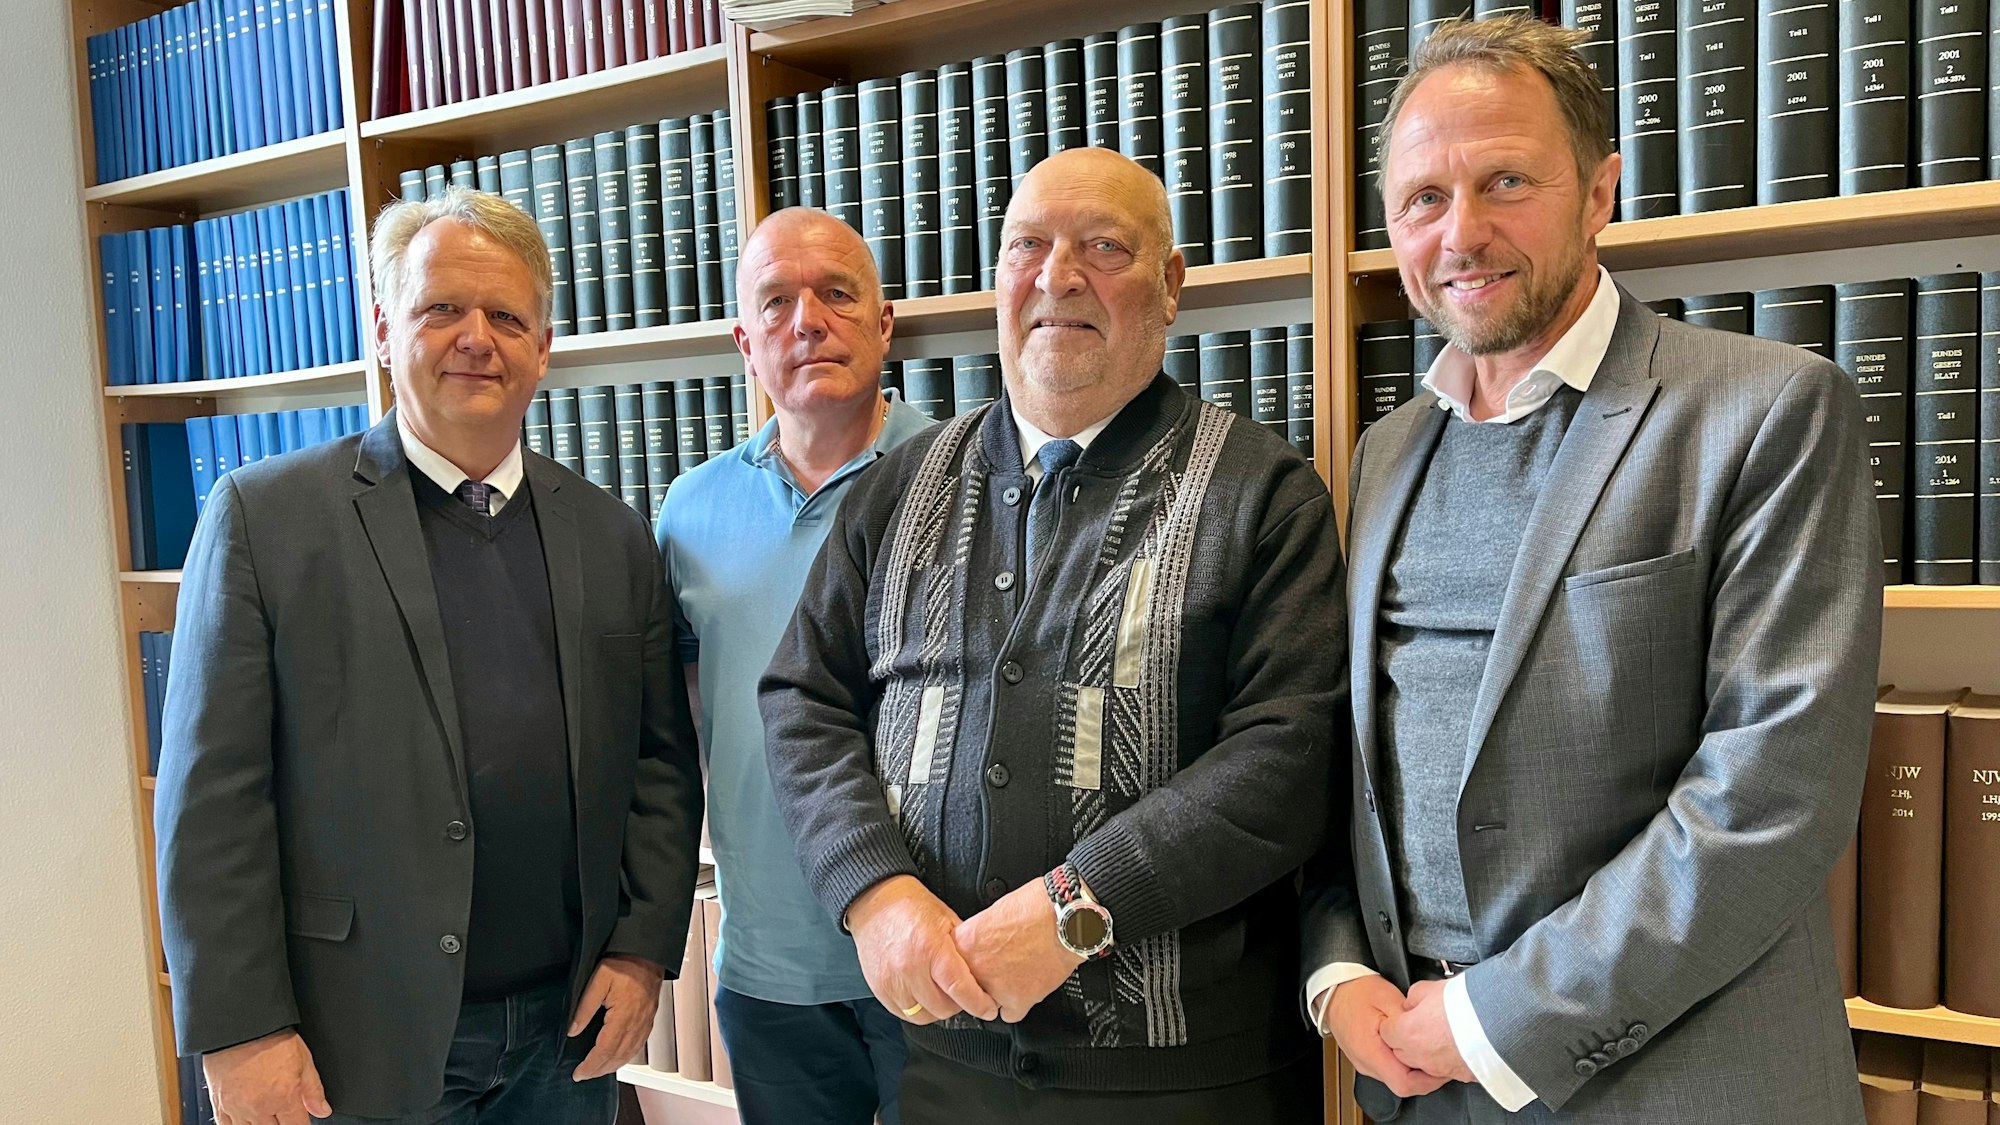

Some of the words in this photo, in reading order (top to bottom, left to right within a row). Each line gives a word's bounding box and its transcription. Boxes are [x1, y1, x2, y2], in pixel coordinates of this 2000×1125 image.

[1576, 3, 1602, 13] BUNDES
[1635, 3, 1661, 13] GESETZ
[1703, 3, 1726, 13] BLATT
[1940, 7, 1954, 15] Teil
[1577, 14, 1602, 23] GESETZ
[1636, 14, 1658, 24] BLATT
[1864, 16, 1877, 24] Teil
[1789, 29, 1802, 38] Teil
[1369, 42, 1391, 52] BUNDES
[1706, 44, 1718, 52] Teil
[1719, 42, 1724, 50] II
[1276, 52, 1297, 61] BUNDES
[1369, 53, 1390, 62] GESETZ
[1639, 54, 1652, 62] Teil
[1938, 50, 1960, 61] 2001
[1276, 62, 1296, 70] GESETZ
[1370, 63, 1388, 71] BLATT
[1862, 59, 1885, 70] 2001
[1220, 65, 1240, 74] BUNDES
[1947, 66, 1954, 74] 2
[1221, 74, 1240, 82] GESETZ
[1279, 71, 1295, 79] BLATT
[1787, 72, 1808, 83] 2001
[1871, 74, 1877, 83] 1
[1126, 83, 1144, 91] BUNDES
[1171, 82, 1189, 90] GESETZ
[1222, 83, 1239, 91] BLATT
[1704, 84, 1726, 95] 2000
[1089, 89, 1107, 97] BUNDES
[1127, 92, 1144, 100] GESETZ
[1172, 92, 1188, 100] BLATT
[1090, 99, 1106, 107] GESETZ
[1638, 94, 1658, 105] 2000
[1128, 101, 1144, 109] BLATT
[1712, 100, 1717, 108] 1
[1644, 109, 1650, 117] 2
[1280, 142, 1295, 150] 1998
[1223, 152, 1237, 160] 1998
[1174, 159, 1188, 167] 1998
[1932, 350, 1963, 358] BUNDES
[1856, 354, 1887, 363] BUNDES
[1857, 365, 1885, 373] GESETZ
[1933, 361, 1962, 369] GESETZ
[1858, 376, 1883, 384] BLATT
[1934, 372, 1960, 380] BLATT
[1870, 457, 1881, 466] 13
[1935, 456, 1957, 465] 2014
[1943, 469, 1948, 478] 1
[1885, 766, 1922, 780] NJW
[1892, 808, 1914, 818] 2014
